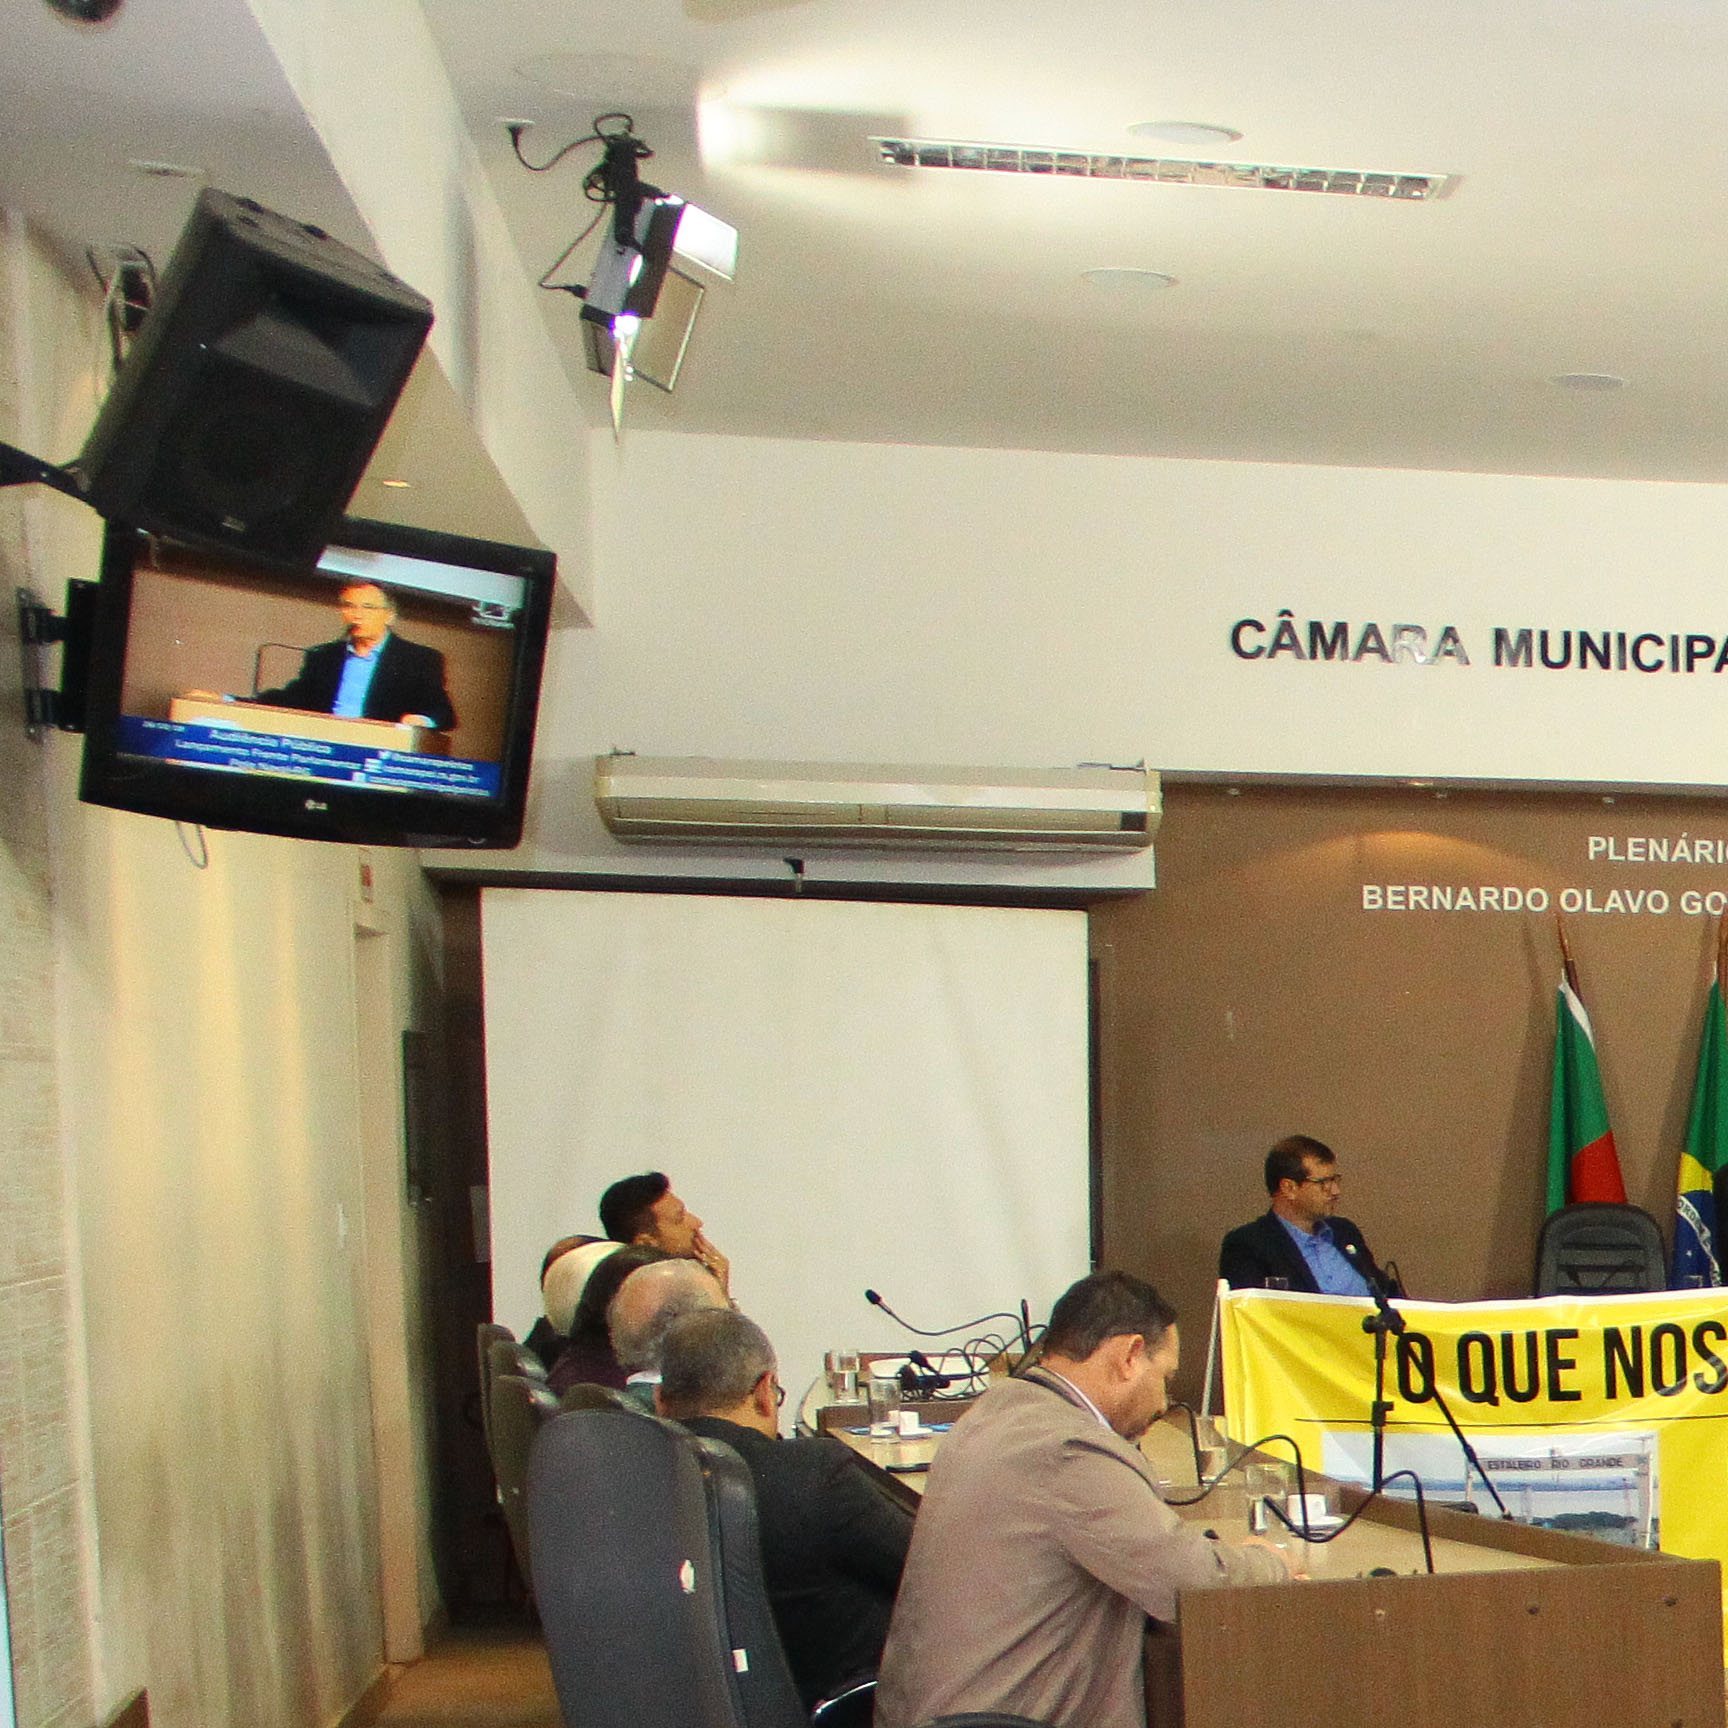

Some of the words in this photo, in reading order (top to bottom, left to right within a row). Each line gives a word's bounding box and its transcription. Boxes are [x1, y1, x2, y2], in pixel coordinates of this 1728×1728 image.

[1229, 608, 1470, 666] CÂMARA
[1362, 884, 1549, 912] BERNARDO
[1559, 887, 1670, 915] OLAVO
[1397, 1331, 1435, 1403] O
[1456, 1328, 1582, 1407] QUE
[1602, 1320, 1728, 1400] NOS
[1487, 1459, 1541, 1471] ESTALEIRO
[1551, 1459, 1570, 1469] RIO
[1580, 1457, 1624, 1468] GRANDE
